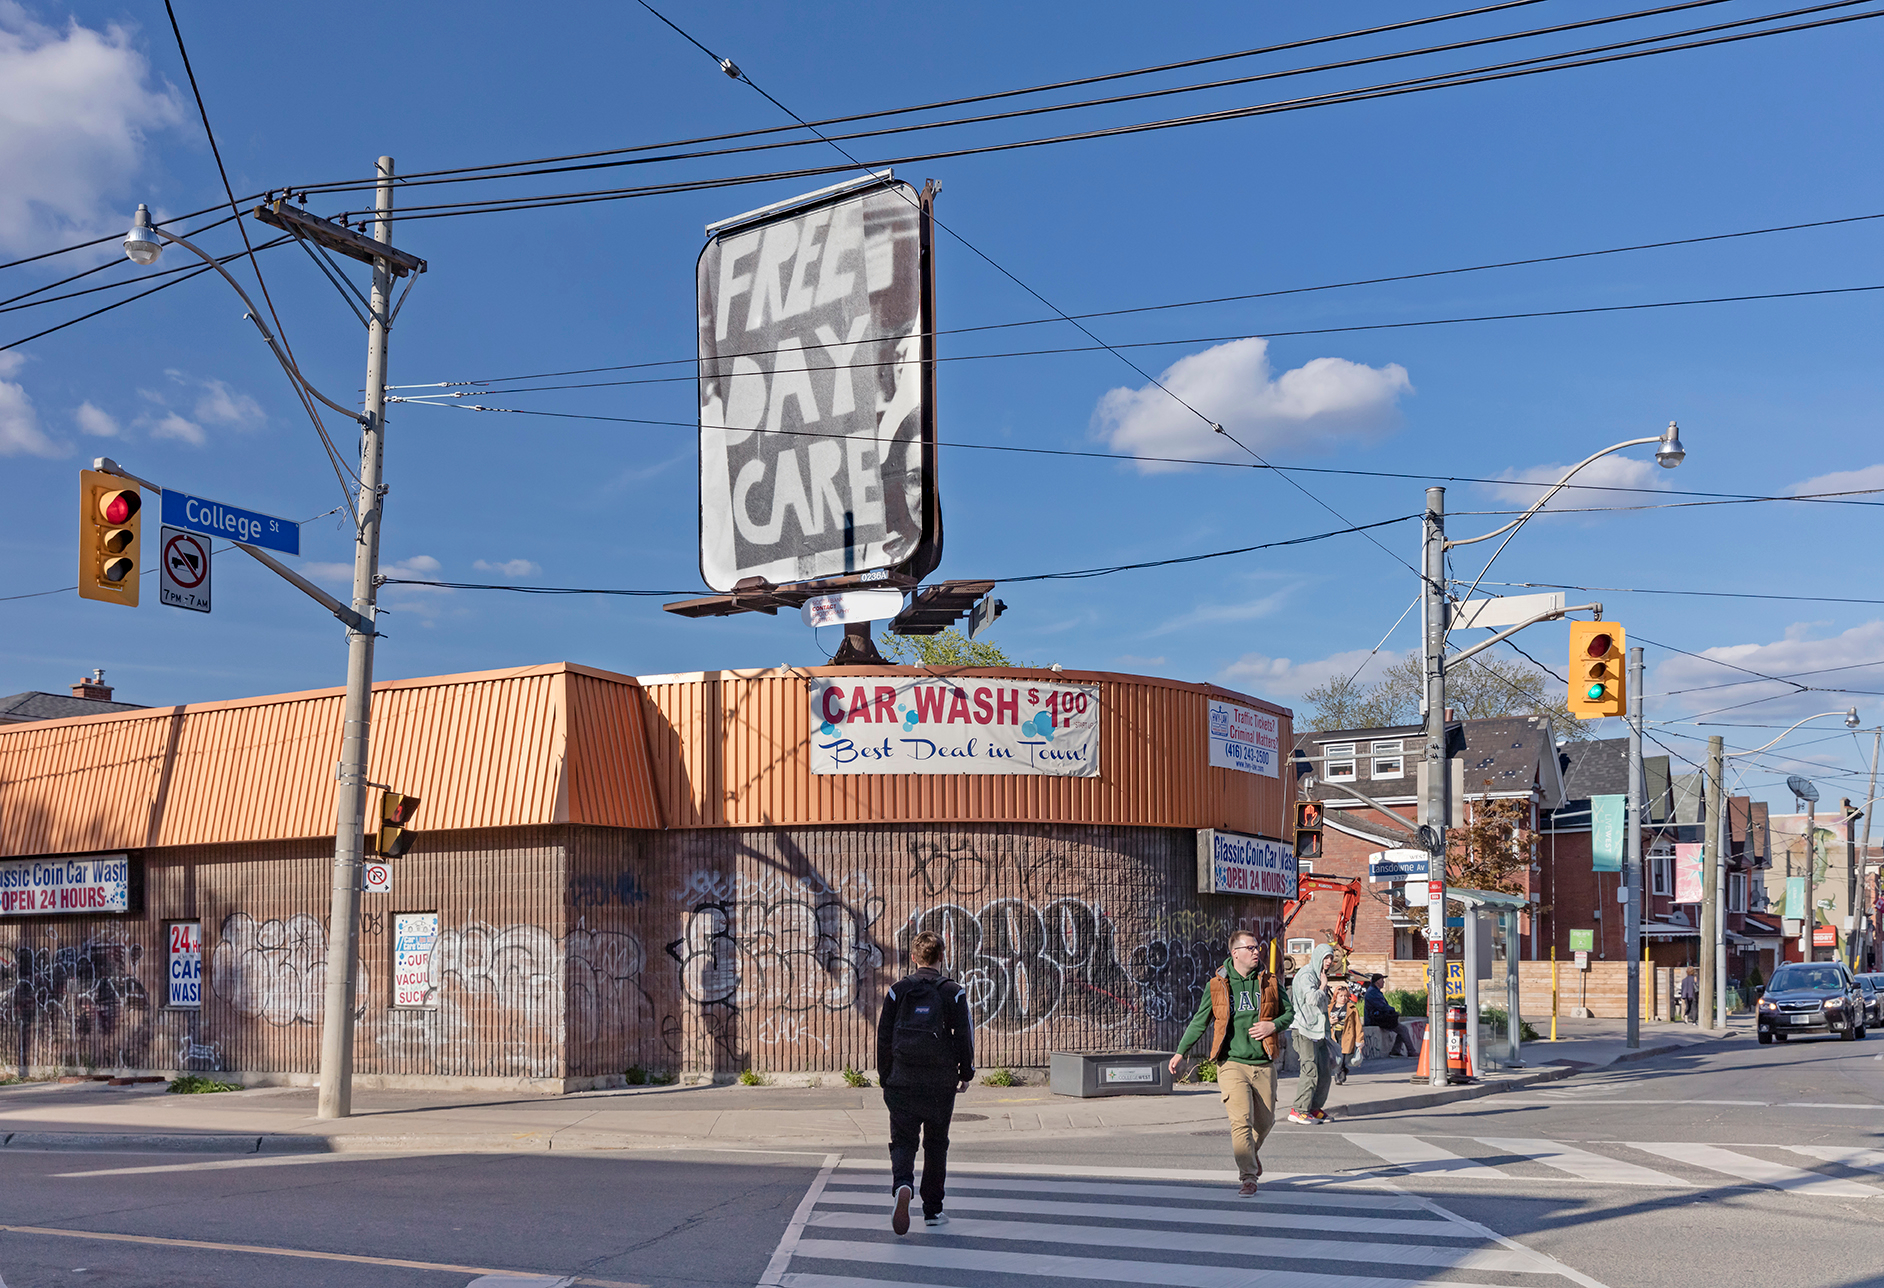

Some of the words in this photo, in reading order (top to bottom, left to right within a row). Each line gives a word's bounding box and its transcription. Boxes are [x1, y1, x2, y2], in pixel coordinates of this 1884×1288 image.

[716, 198, 866, 342] FREE
[724, 313, 871, 446] DAY
[733, 428, 885, 545] CARE
[185, 499, 262, 541] College
[269, 519, 280, 533] St
[861, 571, 887, 582] 0236A
[812, 604, 837, 612] CONTACT
[822, 686, 899, 724] CAR
[914, 686, 1019, 726] WASH
[1233, 708, 1253, 727] Traffic
[1254, 714, 1276, 732] Tickets?
[1230, 725, 1255, 743] Criminal
[1255, 731, 1279, 750] Matters?
[819, 737, 894, 769] Best
[900, 738, 978, 760] Deal
[985, 743, 1015, 758] in
[1016, 741, 1088, 768] Town!
[1225, 742, 1243, 760] (416)
[1243, 746, 1270, 765] 243-2500
[1214, 835, 1245, 865] Classic
[1246, 840, 1264, 868] Coin
[1264, 843, 1277, 869] Car
[33, 862, 64, 887] Coin
[66, 860, 89, 884] Car
[92, 859, 127, 884] Wash
[1226, 866, 1248, 890] OPEN
[1249, 869, 1260, 891] 24
[1261, 871, 1286, 894] HOURS
[1371, 864, 1415, 874] Lansdowne
[1, 890, 36, 911] OPEN
[40, 889, 57, 910] 24
[60, 886, 106, 909] HOURS
[171, 926, 190, 953] 24
[171, 960, 202, 979] CAR
[407, 953, 429, 967] OUR
